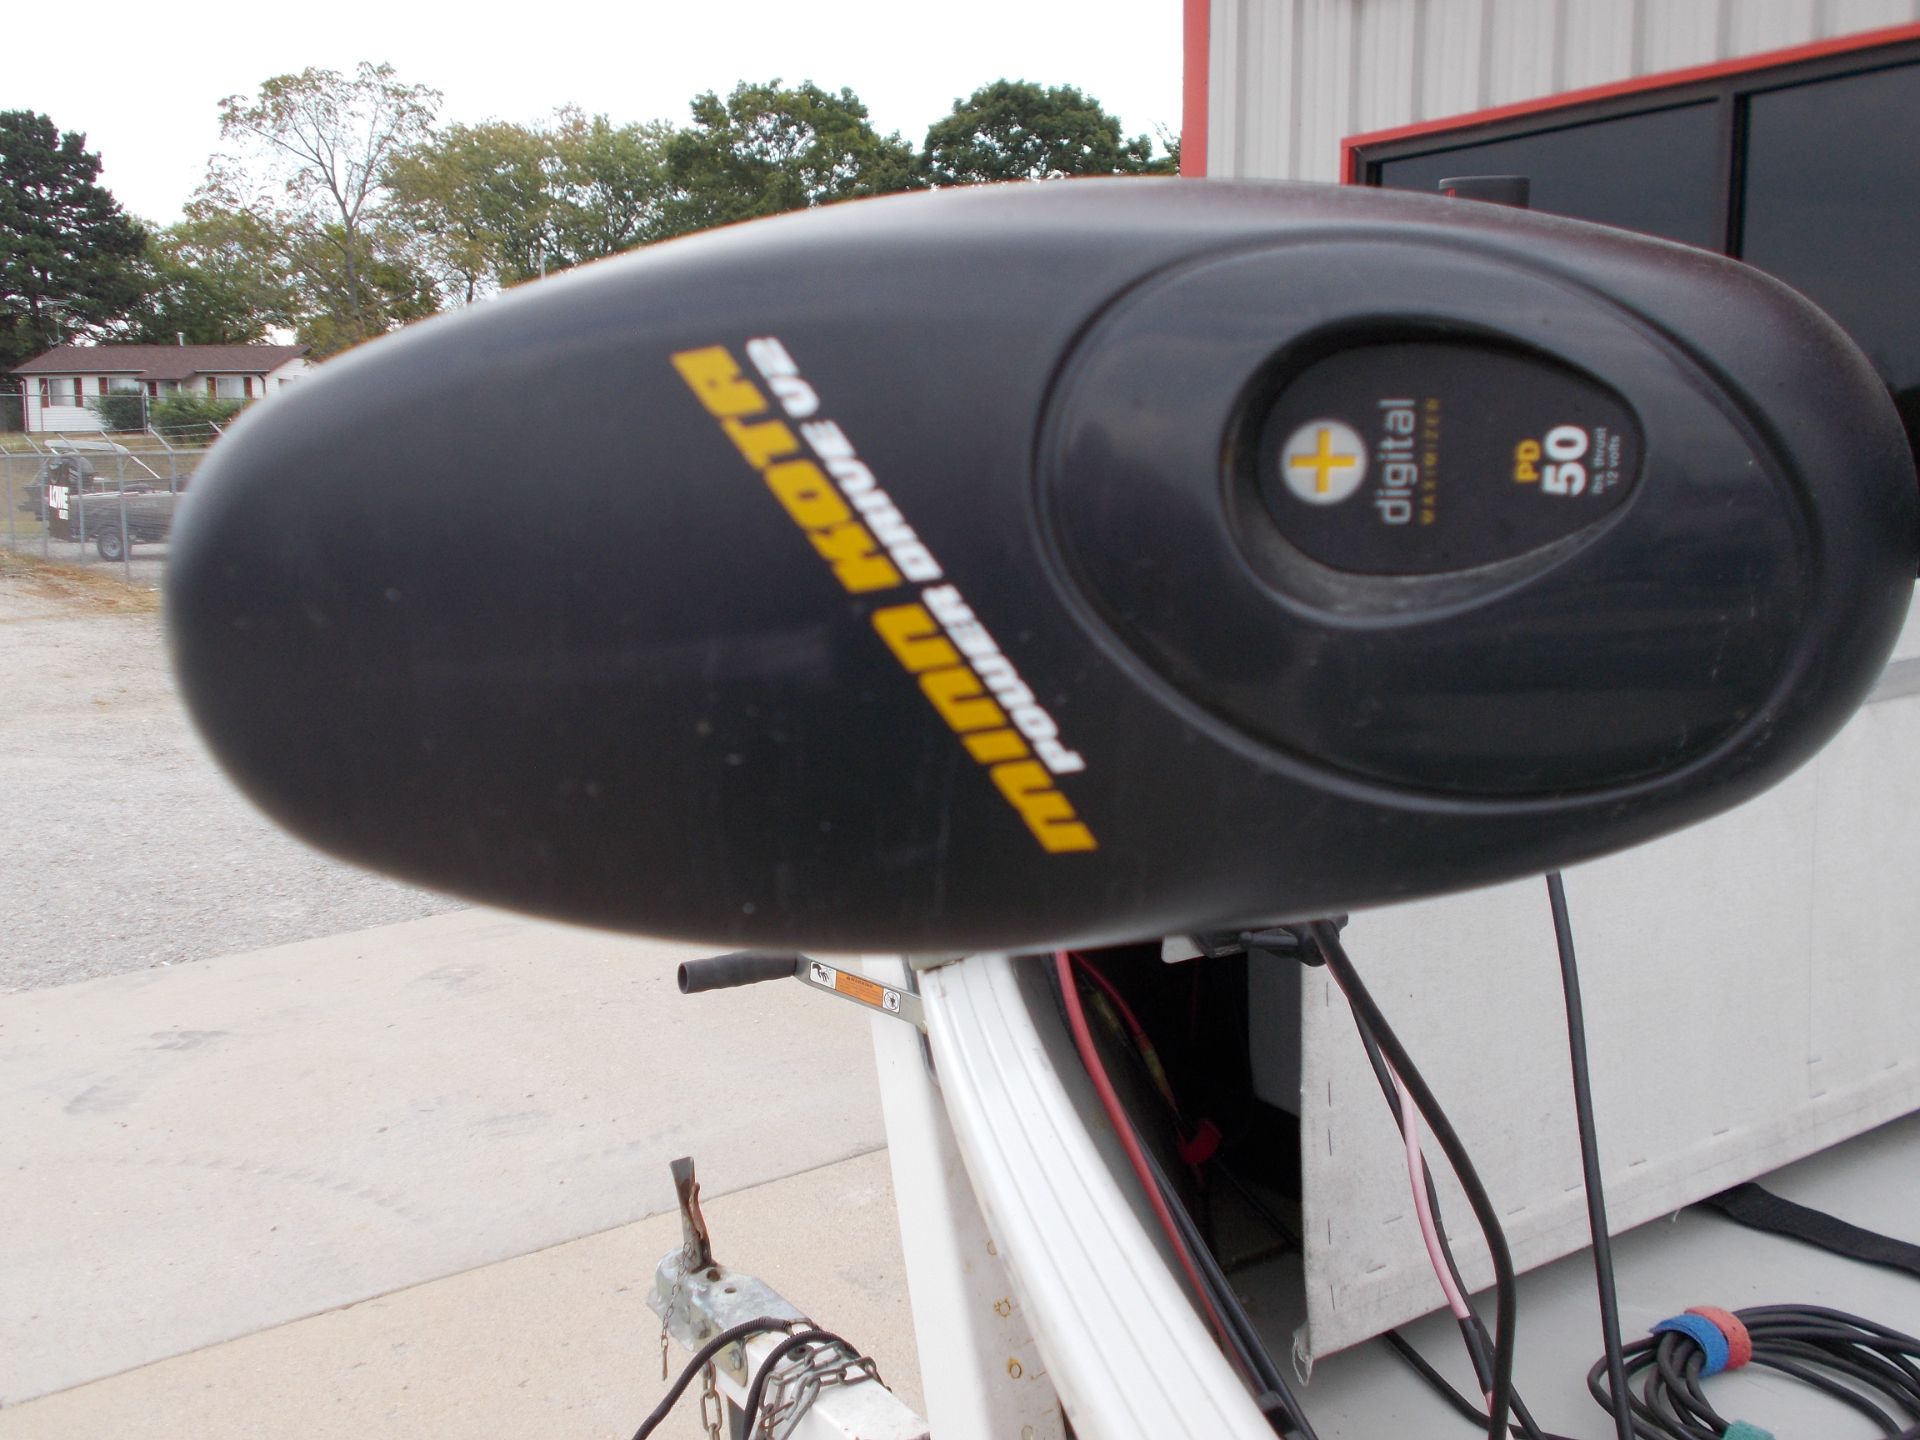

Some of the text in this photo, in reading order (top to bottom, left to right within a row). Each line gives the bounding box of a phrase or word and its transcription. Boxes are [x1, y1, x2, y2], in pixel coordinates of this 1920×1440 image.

[745, 336, 820, 418] V2
[1375, 398, 1417, 524] digital
[1515, 438, 1541, 483] PD
[1542, 425, 1588, 496] 50
[1593, 427, 1606, 468] thrust
[1606, 435, 1620, 486] 12 volts
[671, 345, 1098, 853] MINN KOTA
